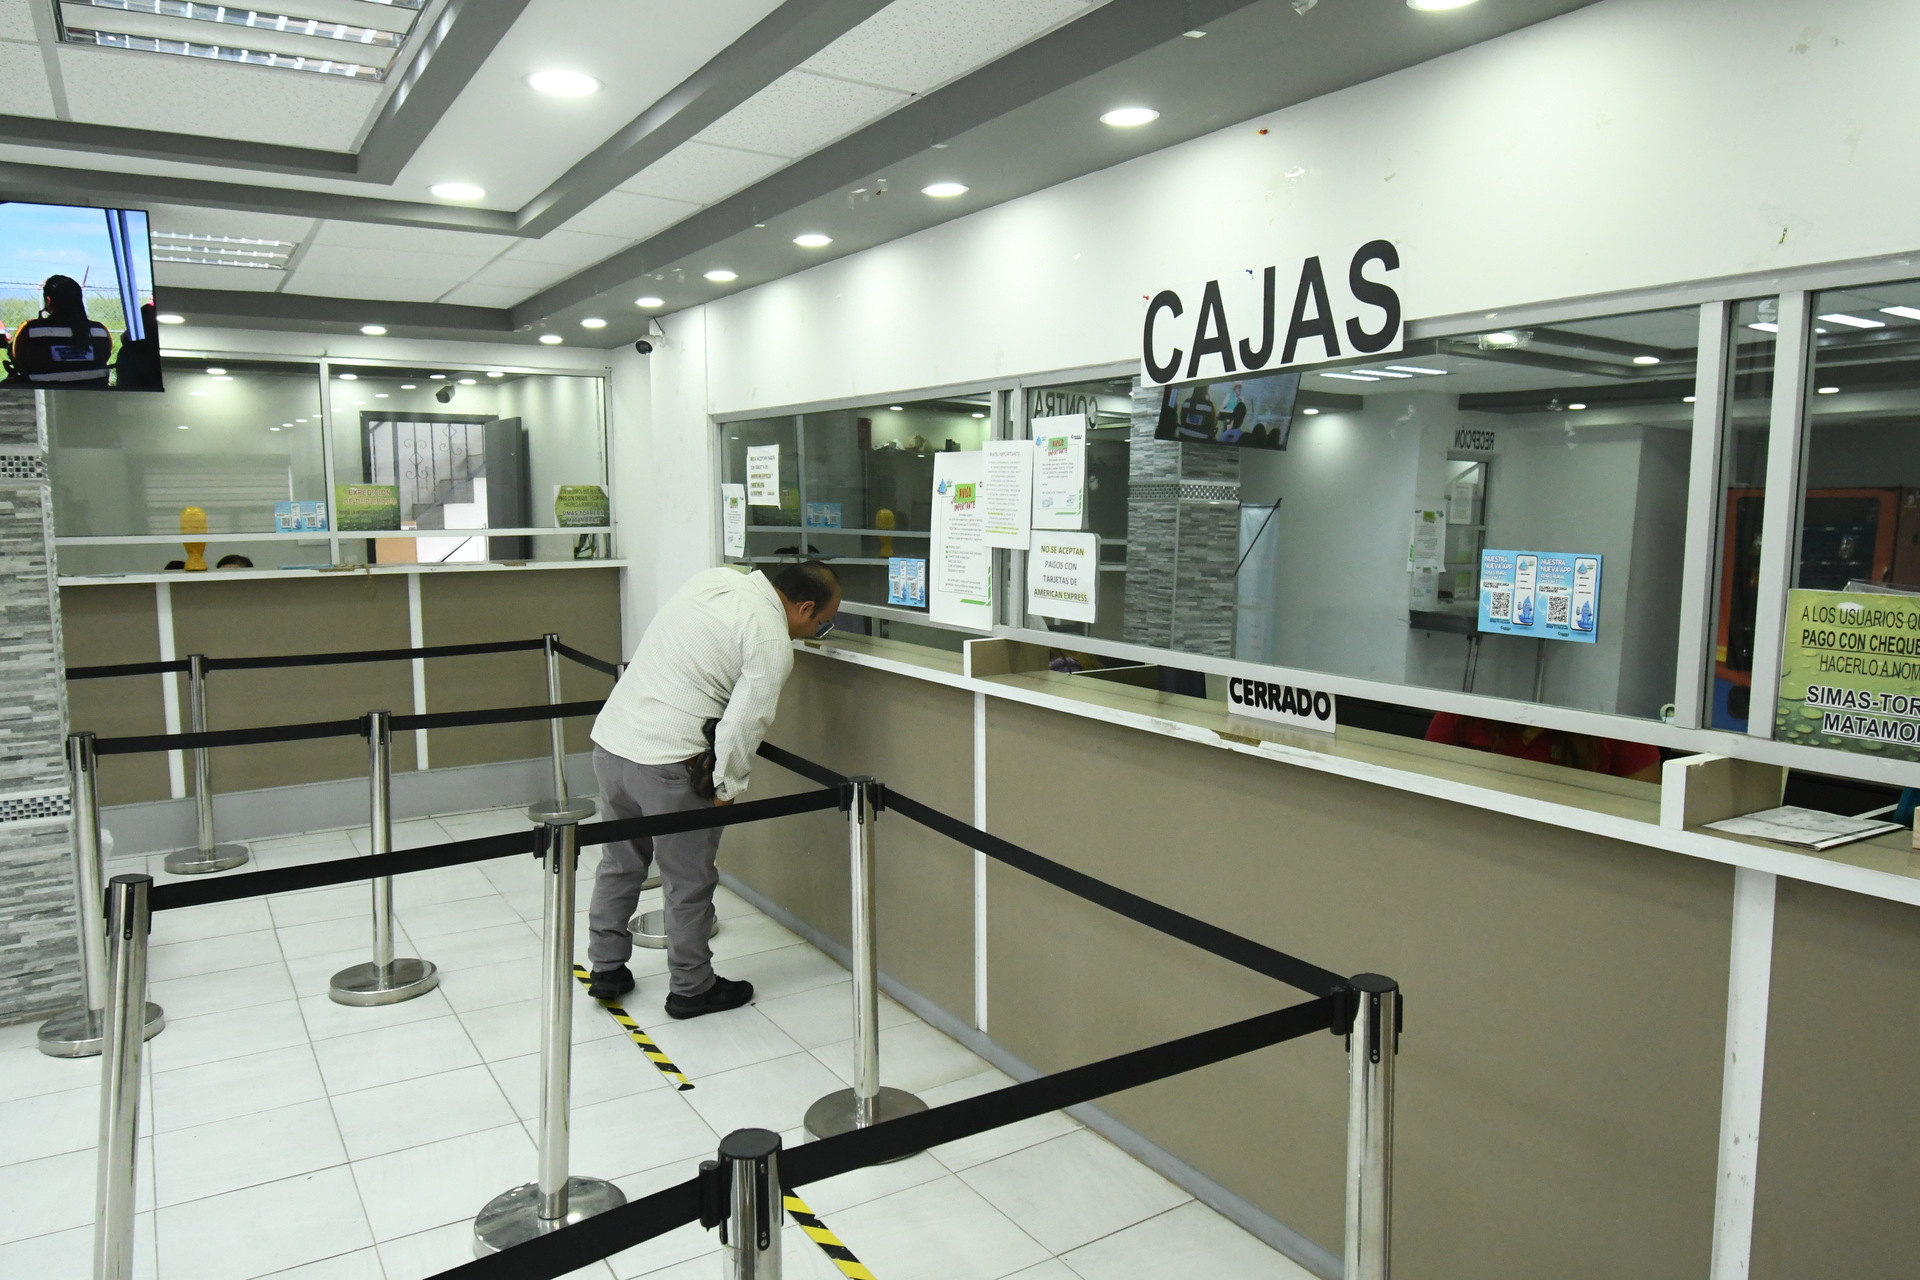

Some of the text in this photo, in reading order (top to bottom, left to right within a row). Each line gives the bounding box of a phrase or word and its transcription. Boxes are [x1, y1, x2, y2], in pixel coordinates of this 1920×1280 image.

[1143, 239, 1401, 384] CAJAS
[1041, 545, 1085, 556] NO SE ACEPTAN
[1044, 560, 1078, 571] PAGOS CON
[1560, 566, 1572, 574] APP
[1043, 575, 1078, 586] TARJETAS DE
[1034, 588, 1063, 599] AMERICAN
[1801, 605, 1920, 631] A LOS USUARIOS Q
[1801, 629, 1836, 647] PAGO
[1839, 632, 1867, 650] CON
[1819, 654, 1879, 676] HACERLO
[1880, 660, 1889, 677] A
[1229, 677, 1332, 721] CERRADO
[1823, 713, 1920, 743] MATAMO
